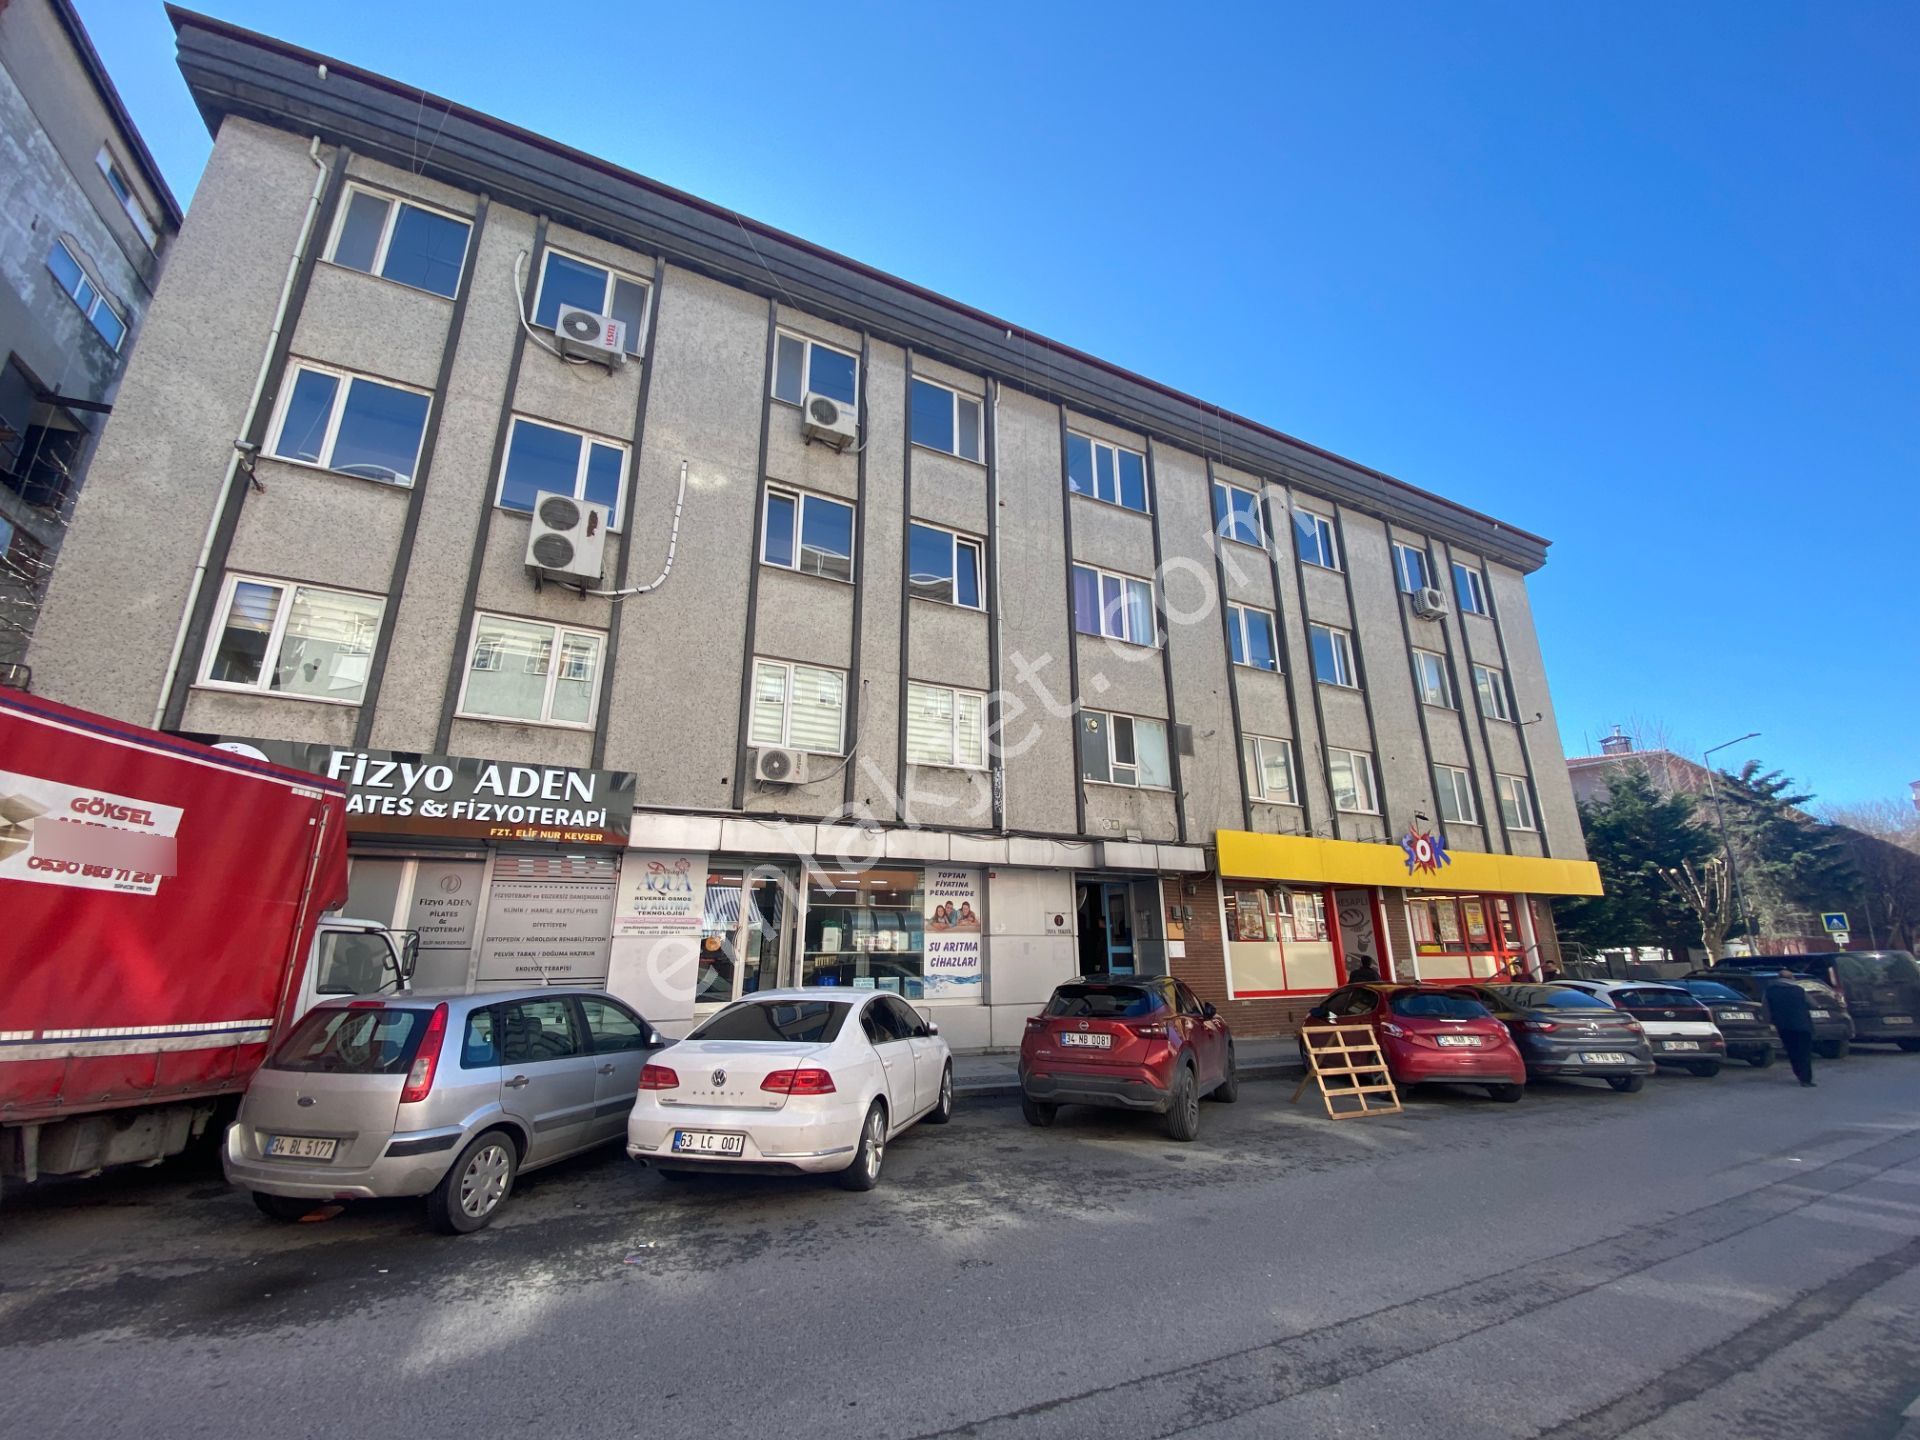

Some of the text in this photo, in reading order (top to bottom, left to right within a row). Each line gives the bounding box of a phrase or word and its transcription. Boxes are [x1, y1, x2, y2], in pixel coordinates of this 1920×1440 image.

[605, 323, 617, 346] VESTEL
[473, 764, 596, 803] ADEN
[70, 797, 155, 826] GÖKSEL
[345, 794, 607, 828] ATES & FİZYOTERAPİ
[515, 827, 537, 838] ELİF
[540, 830, 561, 840] NUR
[564, 832, 603, 842] KEVSER
[938, 871, 967, 879] TOPTAN
[636, 871, 693, 896] AQUA
[935, 880, 969, 888] FİYATINA
[929, 889, 975, 897] PERAKENDE
[446, 899, 472, 907] ADEN
[929, 942, 978, 952] SU ARITMA
[930, 955, 978, 968] CİHAZLARI
[1066, 1033, 1075, 1043] 34
[1079, 1034, 1088, 1044] NB
[272, 1138, 334, 1157] 34 BL 5177
[680, 1133, 741, 1151] 63 LC 001
